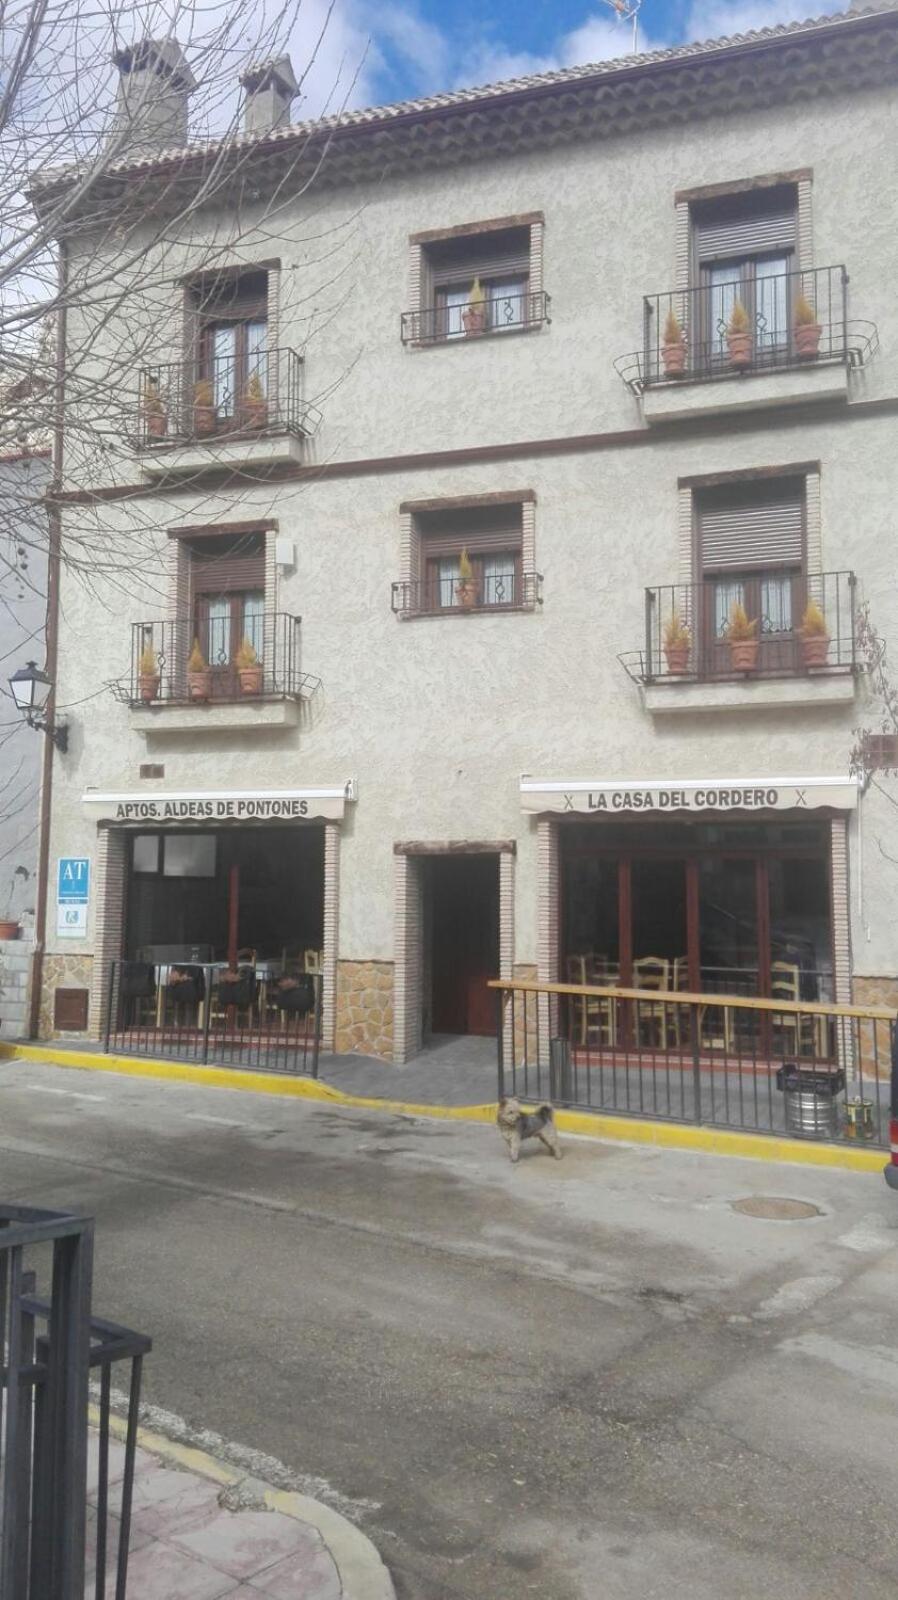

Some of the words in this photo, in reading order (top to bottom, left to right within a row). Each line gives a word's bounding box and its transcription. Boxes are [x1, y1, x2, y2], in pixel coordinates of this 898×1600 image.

[588, 792, 608, 809] LA
[611, 791, 655, 809] CASA
[659, 790, 690, 808] DEL
[694, 789, 778, 807] CORDERO
[116, 802, 161, 818] APTOS.
[164, 801, 213, 817] ALDEAS
[217, 801, 234, 816] DE
[237, 800, 308, 816] PONTONES
[63, 861, 86, 880] AT
